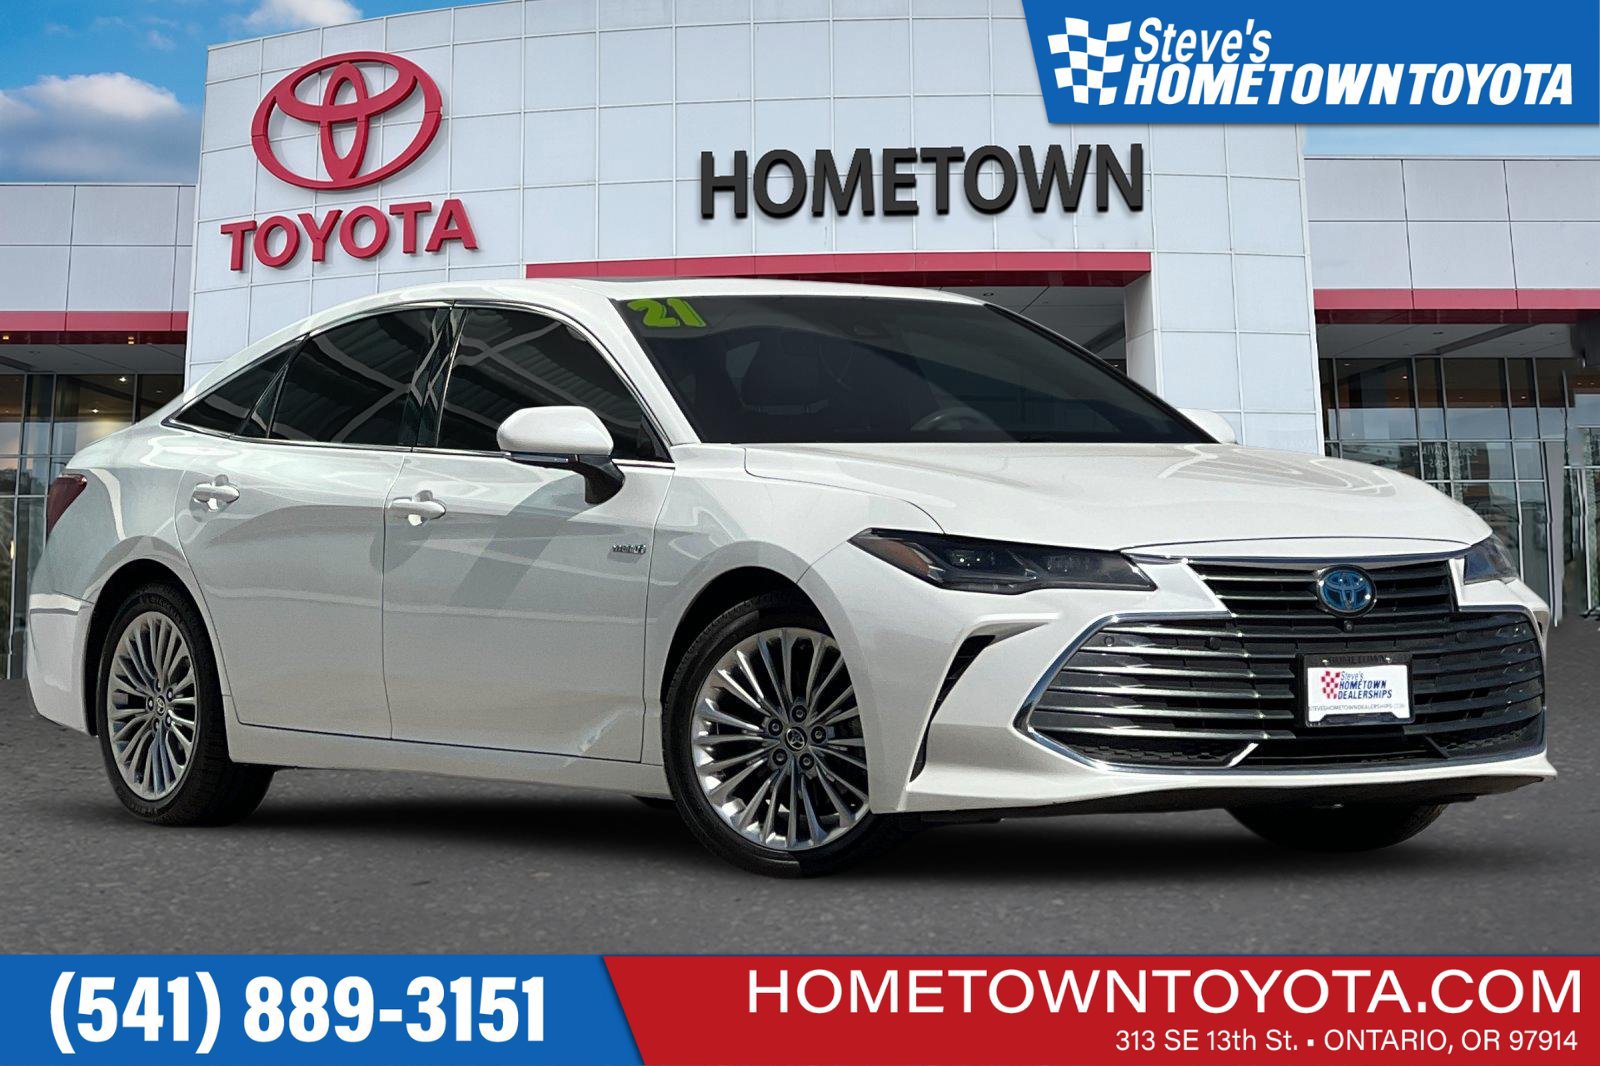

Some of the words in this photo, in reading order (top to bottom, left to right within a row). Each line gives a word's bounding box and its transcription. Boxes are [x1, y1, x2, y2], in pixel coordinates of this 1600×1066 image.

[700, 143, 1144, 219] HOMETOWN
[220, 198, 479, 272] TOYOTA
[627, 298, 706, 328] 21
[1339, 680, 1387, 690] HOMETOWN
[1340, 671, 1364, 681] Steve's
[1338, 689, 1393, 700] DEALERSHIPS
